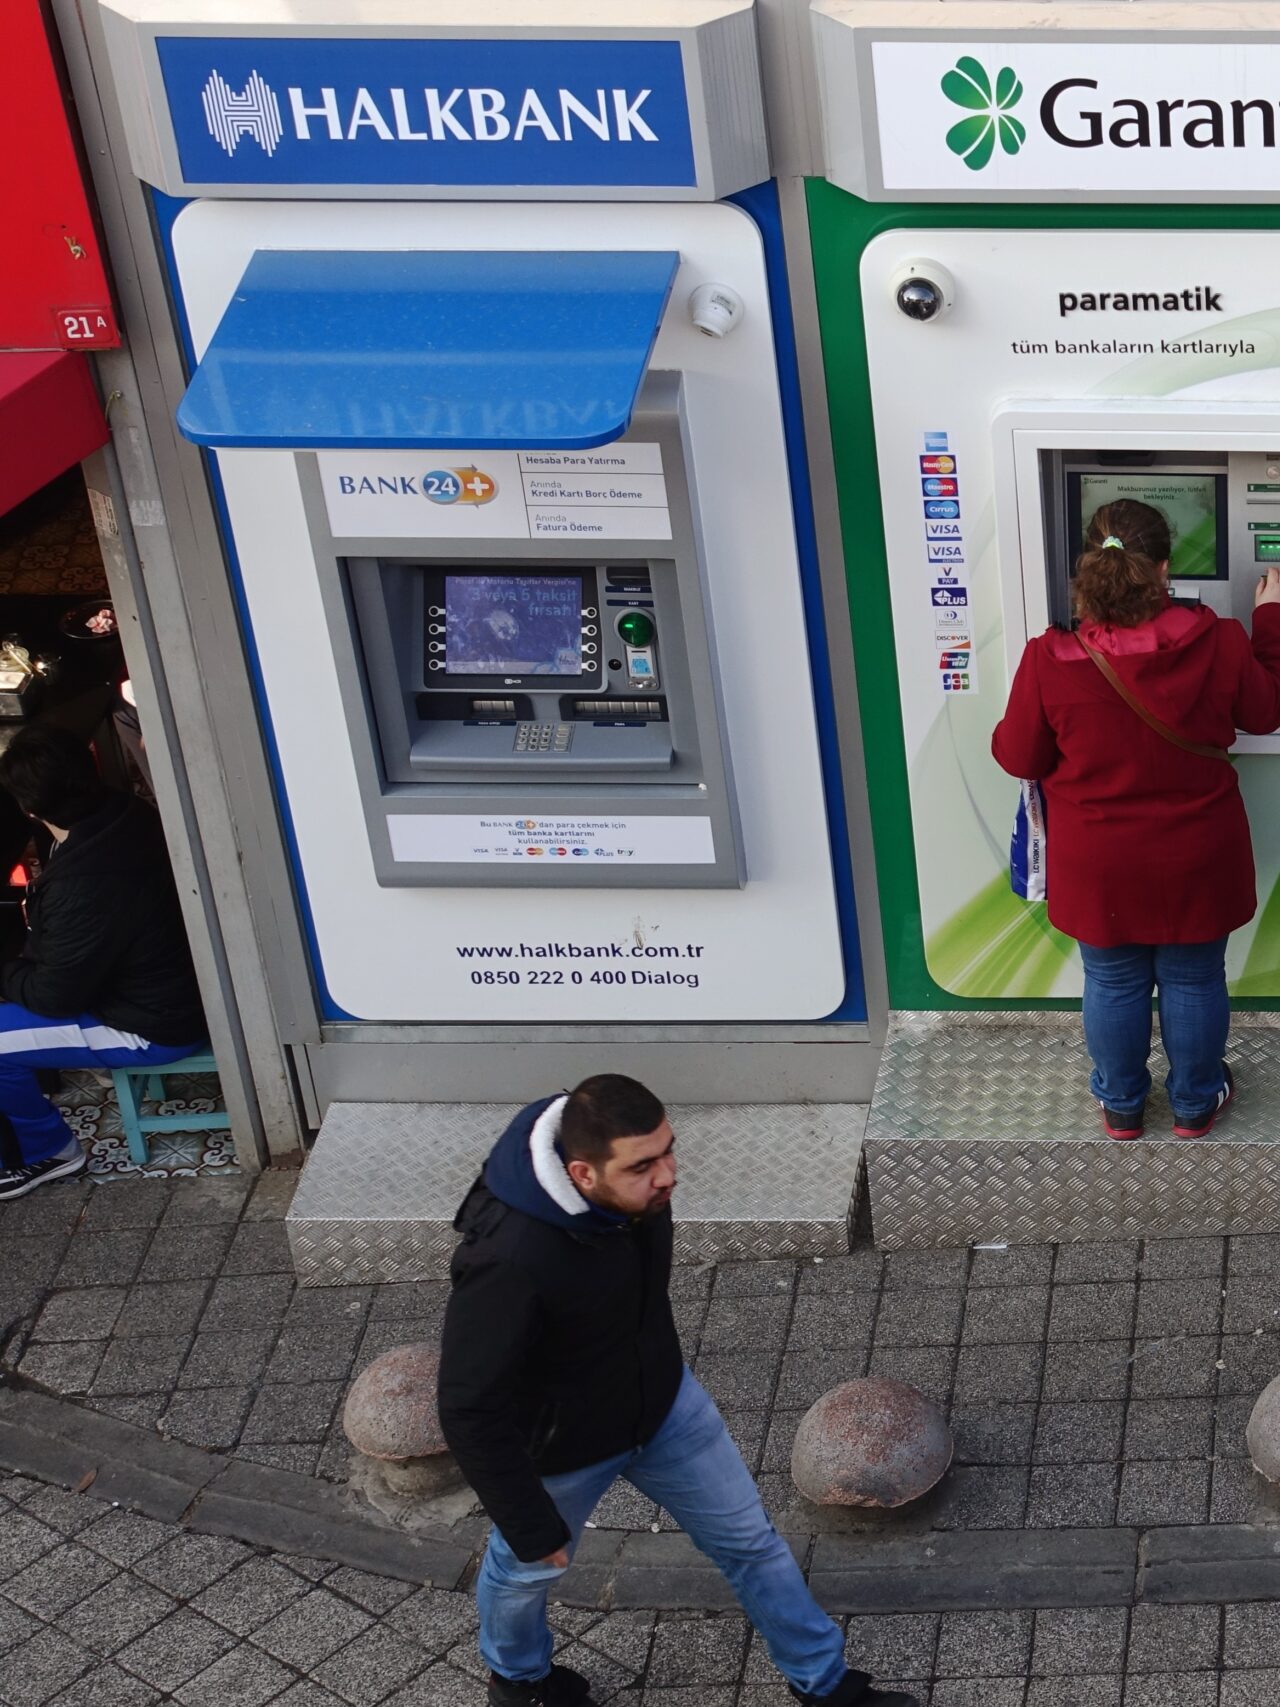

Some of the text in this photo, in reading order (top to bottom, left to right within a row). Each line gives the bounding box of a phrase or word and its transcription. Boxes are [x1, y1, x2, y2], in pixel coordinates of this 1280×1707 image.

[287, 87, 660, 142] HALKBANK
[1058, 286, 1224, 317] paramatik
[1011, 339, 1256, 357] tüm bankaların kartlarıyla
[526, 456, 626, 466] Hesaba Para Yatırma
[339, 475, 420, 495] BANK
[530, 480, 562, 489] Anında
[531, 488, 643, 499] Kredi Kartı Borç Ödeme
[535, 513, 567, 523] Anında
[536, 521, 603, 532] Fatura Ödeme
[931, 524, 960, 534] VISA
[932, 546, 962, 556] VISA
[536, 588, 578, 601] taksit
[942, 596, 966, 605] PLUS
[456, 943, 705, 958] www.halkbank.com.tr
[470, 971, 700, 988] 0850 222 0 400 Dialog
